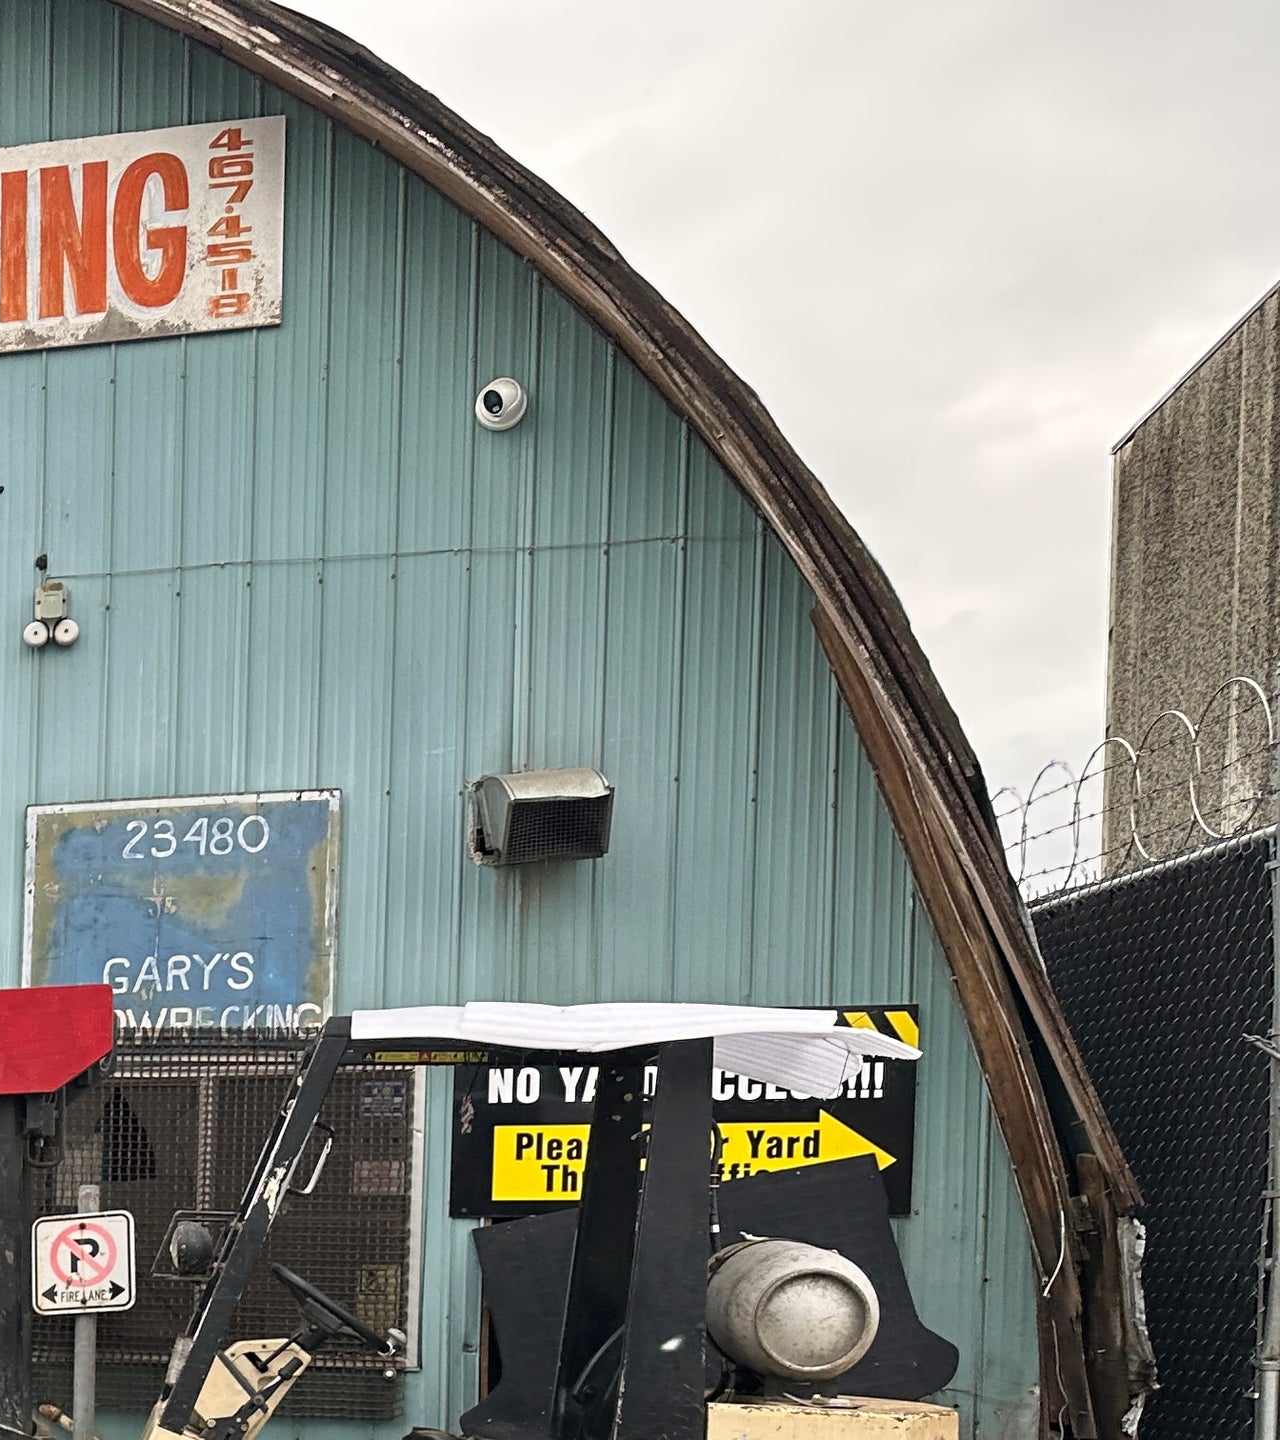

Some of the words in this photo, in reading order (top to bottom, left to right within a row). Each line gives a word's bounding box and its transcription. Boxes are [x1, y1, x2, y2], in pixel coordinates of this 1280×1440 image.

[122, 814, 270, 860] 23480
[102, 951, 256, 995] GARY'S
[488, 1066, 541, 1104] NO
[746, 1129, 821, 1159] Yard
[60, 1290, 81, 1303] FIRE
